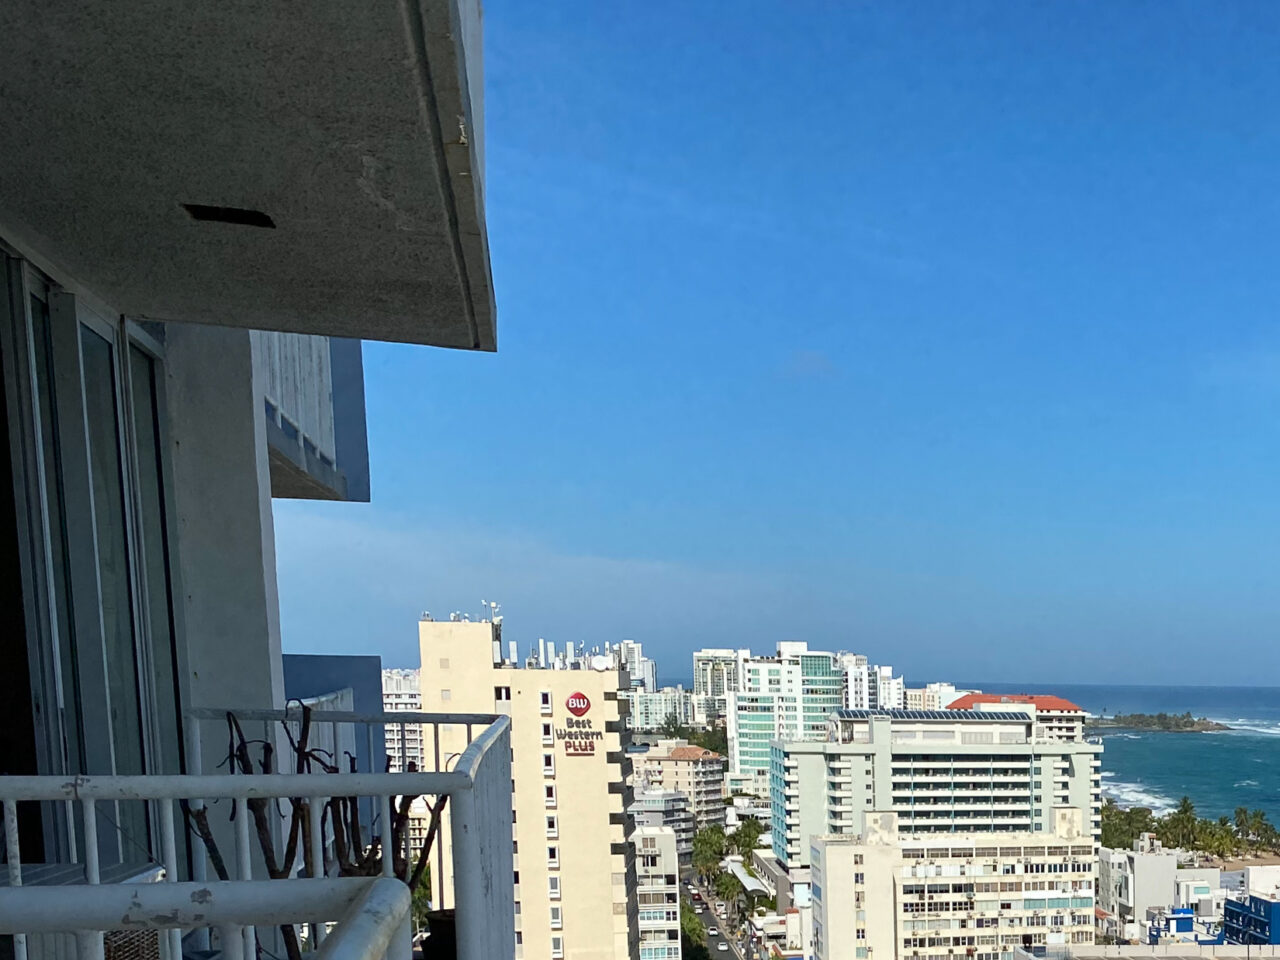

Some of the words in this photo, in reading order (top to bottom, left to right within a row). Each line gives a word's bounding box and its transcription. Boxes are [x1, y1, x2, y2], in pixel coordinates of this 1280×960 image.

[568, 698, 588, 709] BW
[566, 717, 592, 729] Best
[555, 728, 604, 740] Western
[564, 740, 595, 752] PLUS
